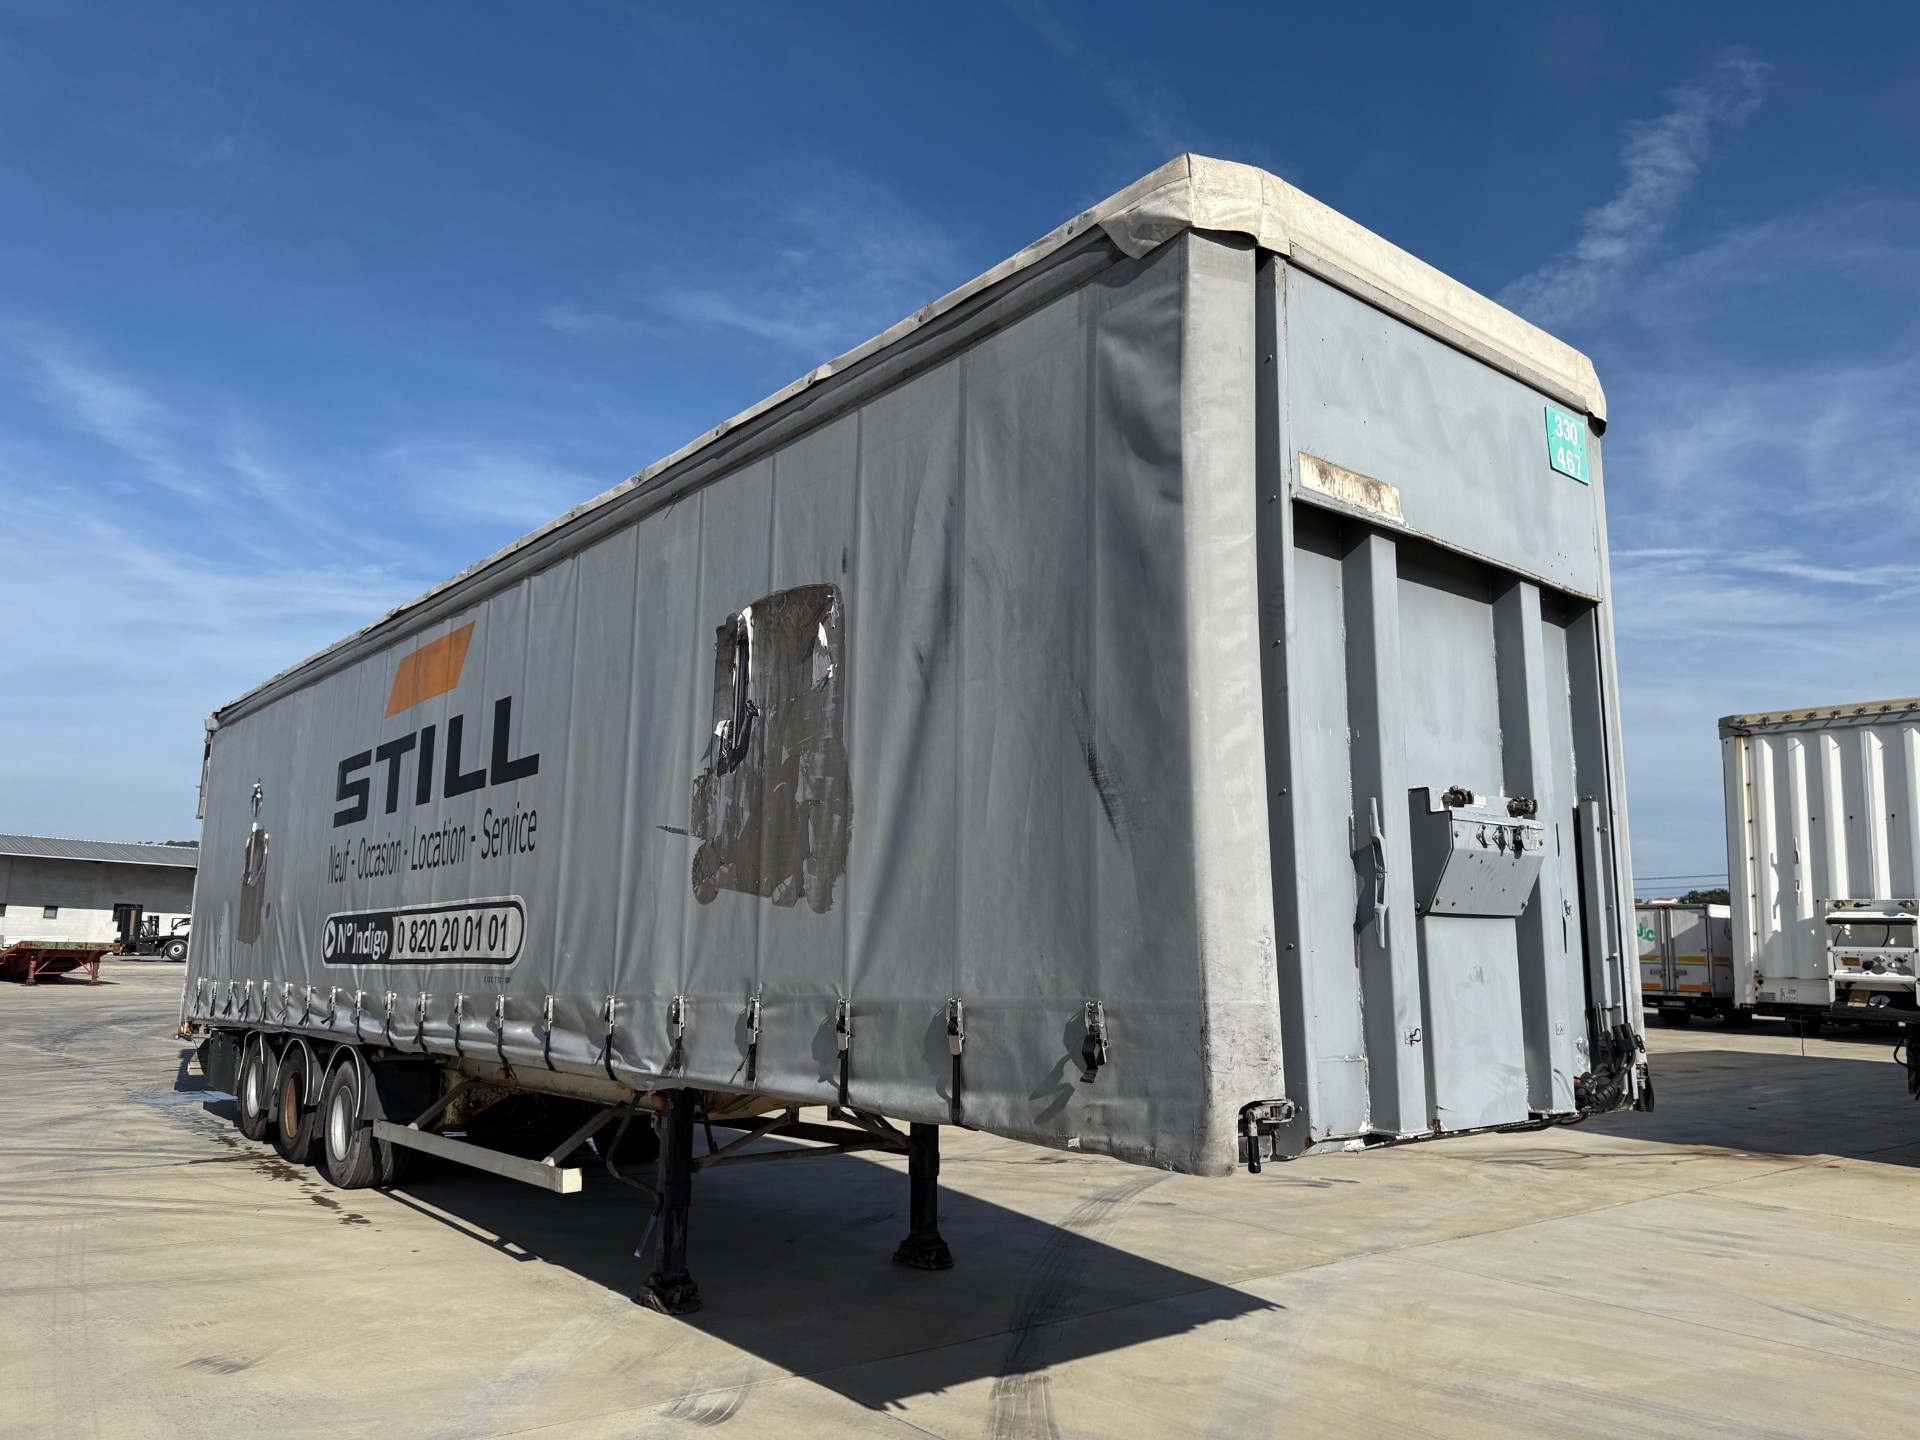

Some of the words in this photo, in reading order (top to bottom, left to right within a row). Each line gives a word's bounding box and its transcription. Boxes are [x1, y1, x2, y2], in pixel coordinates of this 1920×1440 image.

[1555, 414, 1578, 446] 330
[1557, 446, 1581, 477] 467
[333, 695, 540, 829] STILL
[328, 839, 351, 884] Neuf
[357, 832, 401, 880] Occasion
[411, 817, 466, 871] Location
[481, 801, 537, 860] Service
[397, 921, 405, 954] 0
[409, 918, 437, 954] 820
[439, 916, 459, 953] 20
[463, 914, 483, 952] 01
[488, 913, 508, 952] 01
